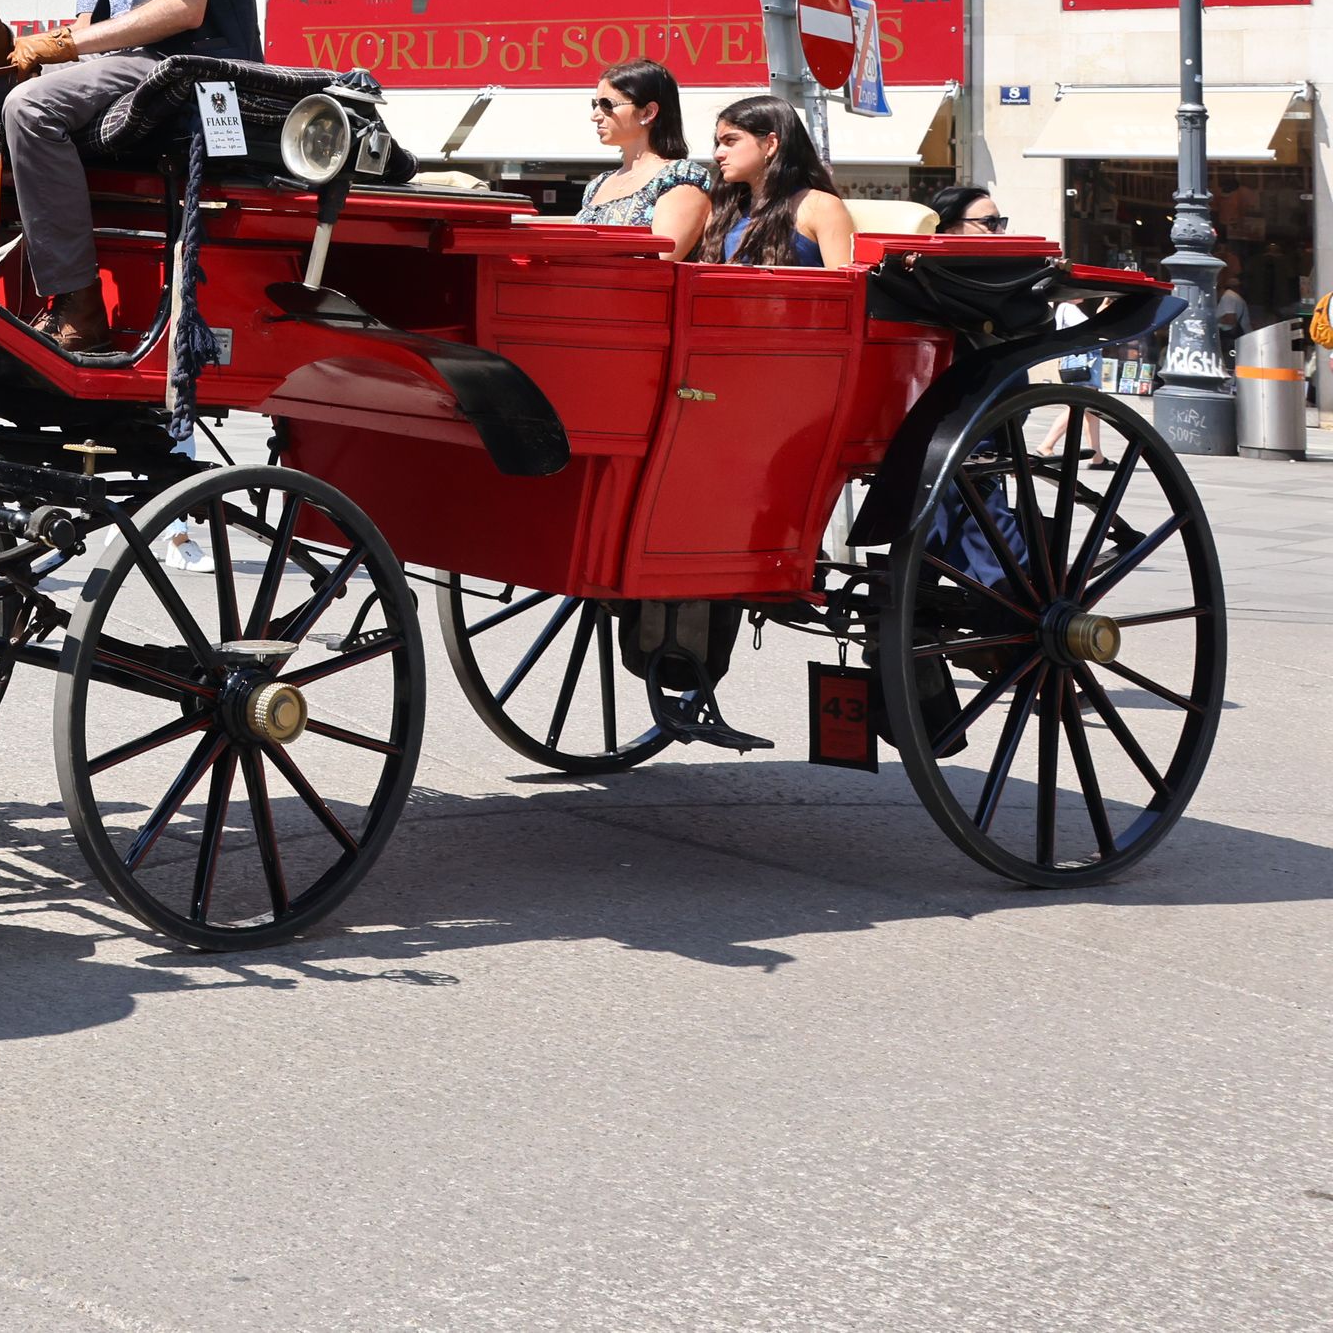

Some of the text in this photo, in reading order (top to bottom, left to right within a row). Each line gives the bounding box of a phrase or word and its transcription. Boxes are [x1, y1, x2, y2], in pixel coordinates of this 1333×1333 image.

[304, 16, 904, 72] WORLD of SOUVES
[857, 84, 877, 106] Zone
[1008, 87, 1021, 99] 8
[206, 116, 239, 126] FIAKER
[822, 697, 866, 723] 43
